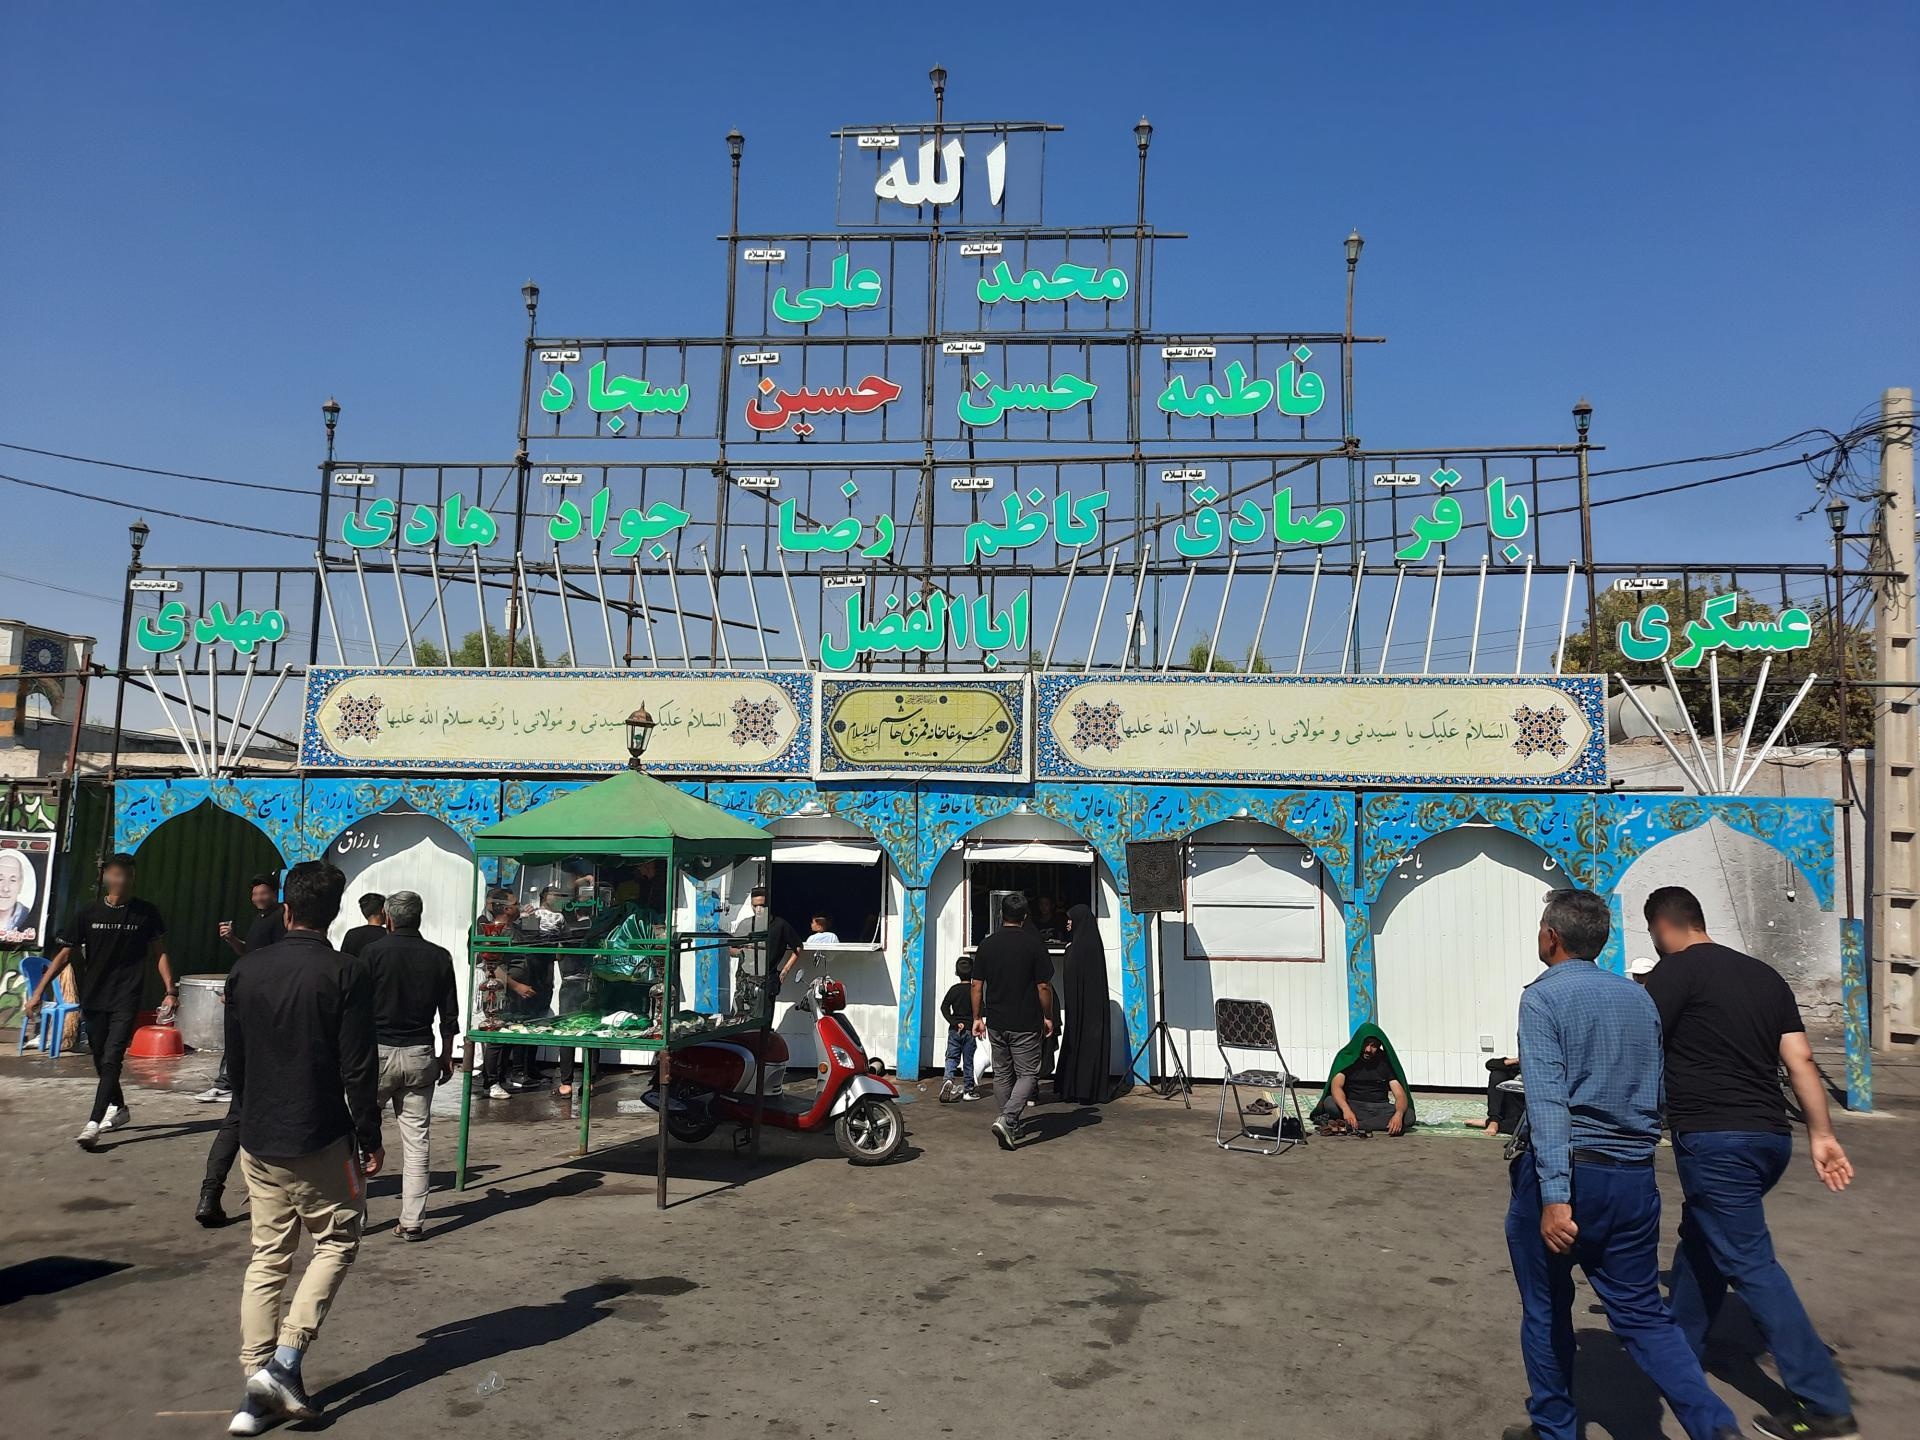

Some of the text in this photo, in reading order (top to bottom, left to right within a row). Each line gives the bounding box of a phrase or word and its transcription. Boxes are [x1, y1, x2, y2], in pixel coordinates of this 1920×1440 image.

[875, 138, 1006, 206] الله
[773, 253, 882, 323] علی
[977, 261, 1128, 303] محمد
[541, 361, 689, 433] سجاد
[957, 371, 1098, 425] حسن
[1157, 345, 1325, 416] فاطمه
[745, 375, 902, 435] حسین
[342, 492, 497, 548] هادی
[549, 487, 690, 560] جواد
[779, 480, 895, 558] رضا
[964, 487, 1109, 565] کاظم
[1174, 486, 1345, 557] صادق
[1395, 468, 1529, 563] باقر
[136, 601, 285, 654] مهدی
[1619, 592, 1813, 669] عسگری
[513, 709, 519, 735] یا
[566, 719, 577, 732] و
[910, 717, 929, 746] قمر
[1267, 719, 1277, 746] یا
[1330, 728, 1341, 742] و
[1405, 721, 1414, 749] یا
[123, 796, 158, 823] یا بصیر
[258, 793, 289, 823] یا سمیع
[346, 794, 354, 819] یا
[447, 792, 490, 821] یا وهاب
[883, 793, 891, 821] یا
[938, 793, 974, 826] یا حافظ
[1074, 793, 1115, 830] یا خالق
[1148, 795, 1186, 827] یا رحیم
[1322, 802, 1332, 831] یا
[1562, 810, 1571, 842] یا
[337, 830, 381, 858] یا رزاق
